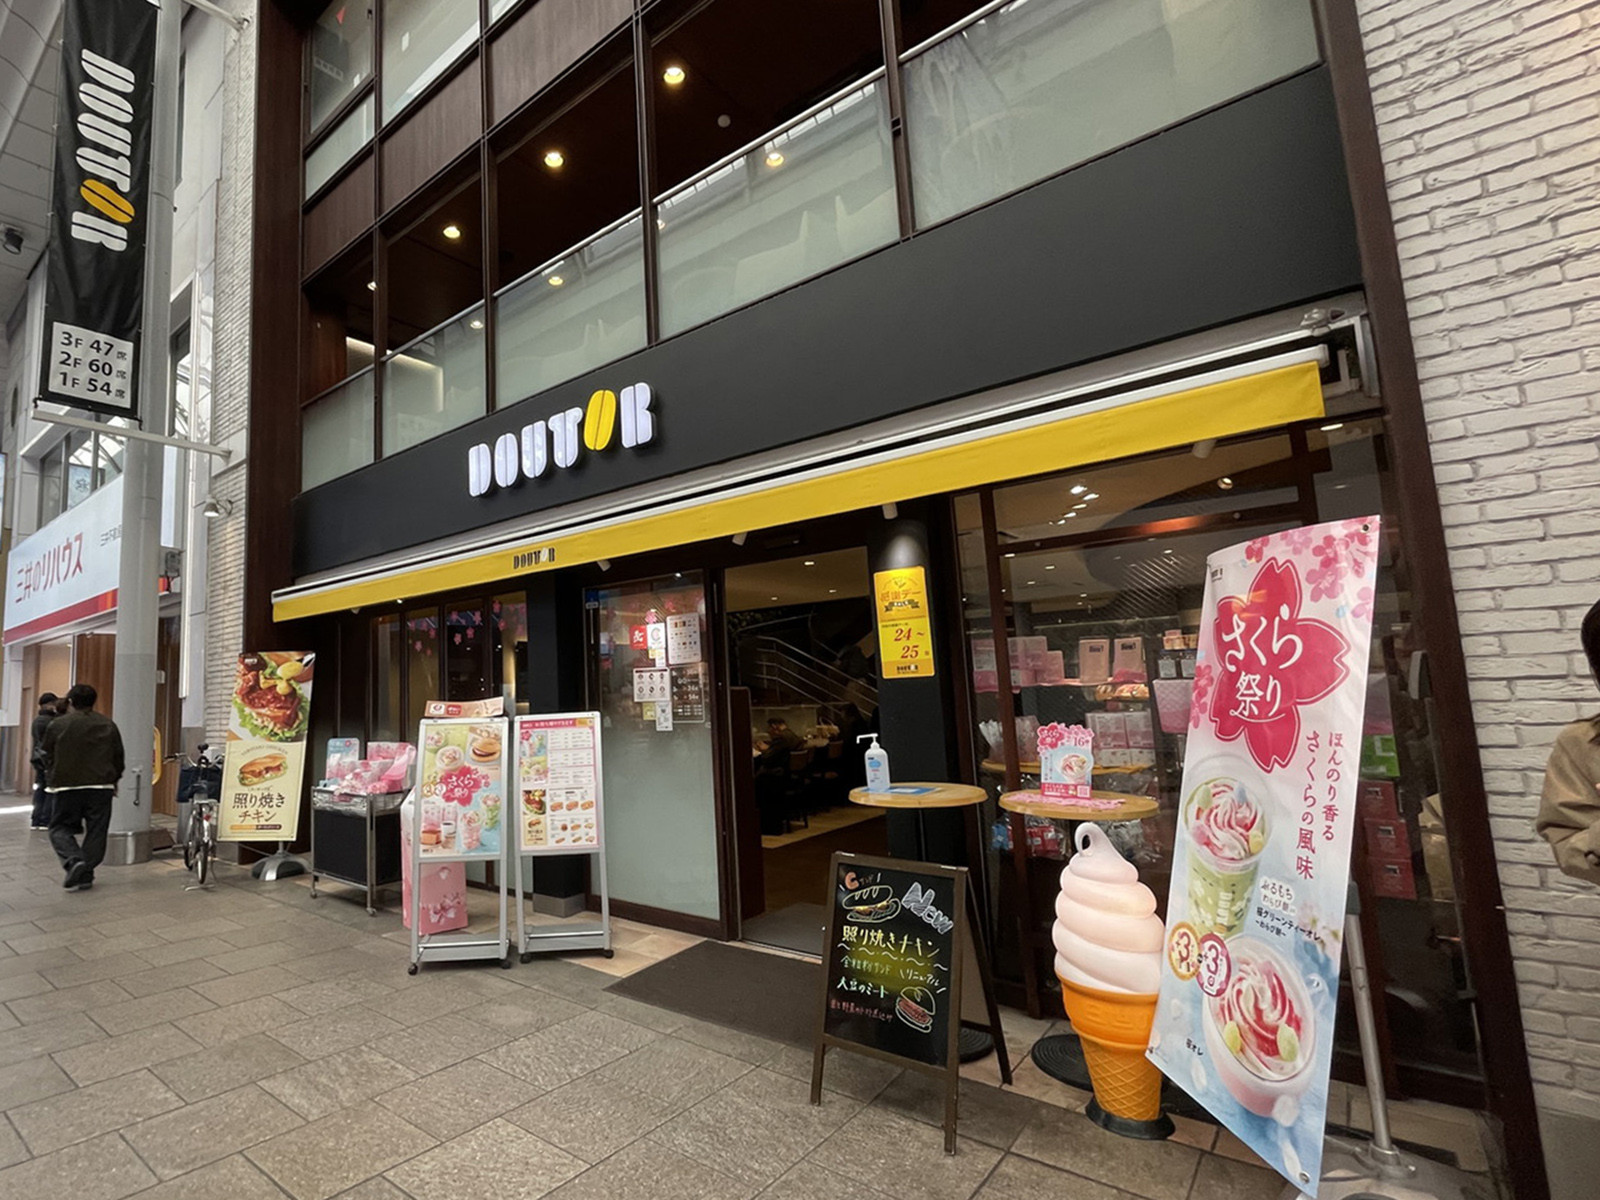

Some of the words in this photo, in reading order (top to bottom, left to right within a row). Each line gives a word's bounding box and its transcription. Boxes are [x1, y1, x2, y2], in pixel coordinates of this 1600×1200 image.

[71, 48, 136, 252] DOUTOR
[60, 331, 83, 348] 3F
[59, 351, 82, 368] 2F
[59, 372, 80, 388] 1F
[468, 382, 654, 498] DOUTOR
[15, 531, 84, 604] 三井のリハウス
[513, 547, 556, 570] DOUTOR
[900, 645, 920, 659] 25
[1221, 603, 1303, 673] さくら
[1229, 670, 1286, 720] 祭り
[447, 774, 475, 790] さくら
[1321, 731, 1343, 842] ほんのり香る
[232, 792, 286, 809] 照り焼き
[238, 809, 277, 824] チキン
[1295, 730, 1321, 881] さくらの風味
[901, 881, 954, 935] New
